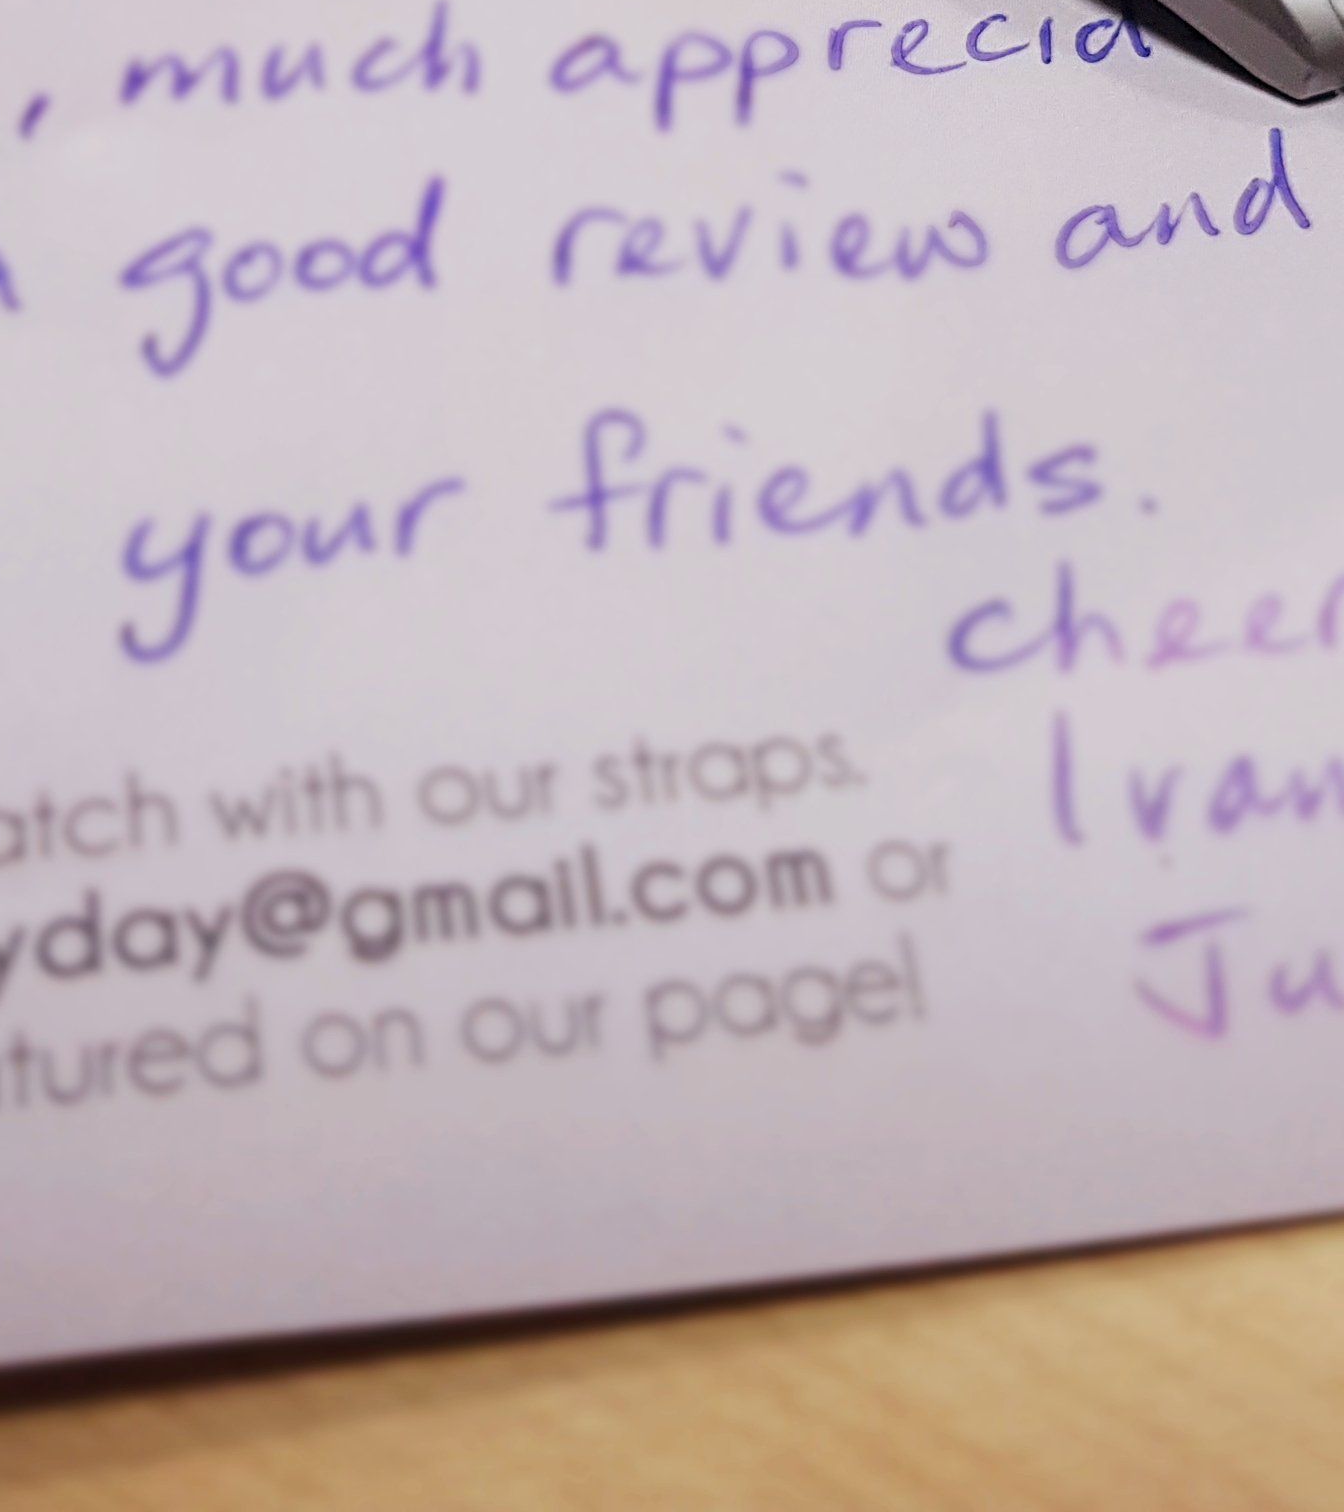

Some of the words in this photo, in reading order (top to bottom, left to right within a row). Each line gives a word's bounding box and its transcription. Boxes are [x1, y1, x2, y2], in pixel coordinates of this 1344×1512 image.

[118, 171, 444, 378] good
[552, 170, 990, 286] review
[1056, 128, 1312, 268] and
[119, 478, 464, 664] your
[549, 408, 1158, 552] friends.
[209, 754, 384, 840] with
[416, 758, 556, 828] our
[866, 840, 950, 902] or
[301, 1008, 424, 1080] on
[461, 988, 606, 1066] our
